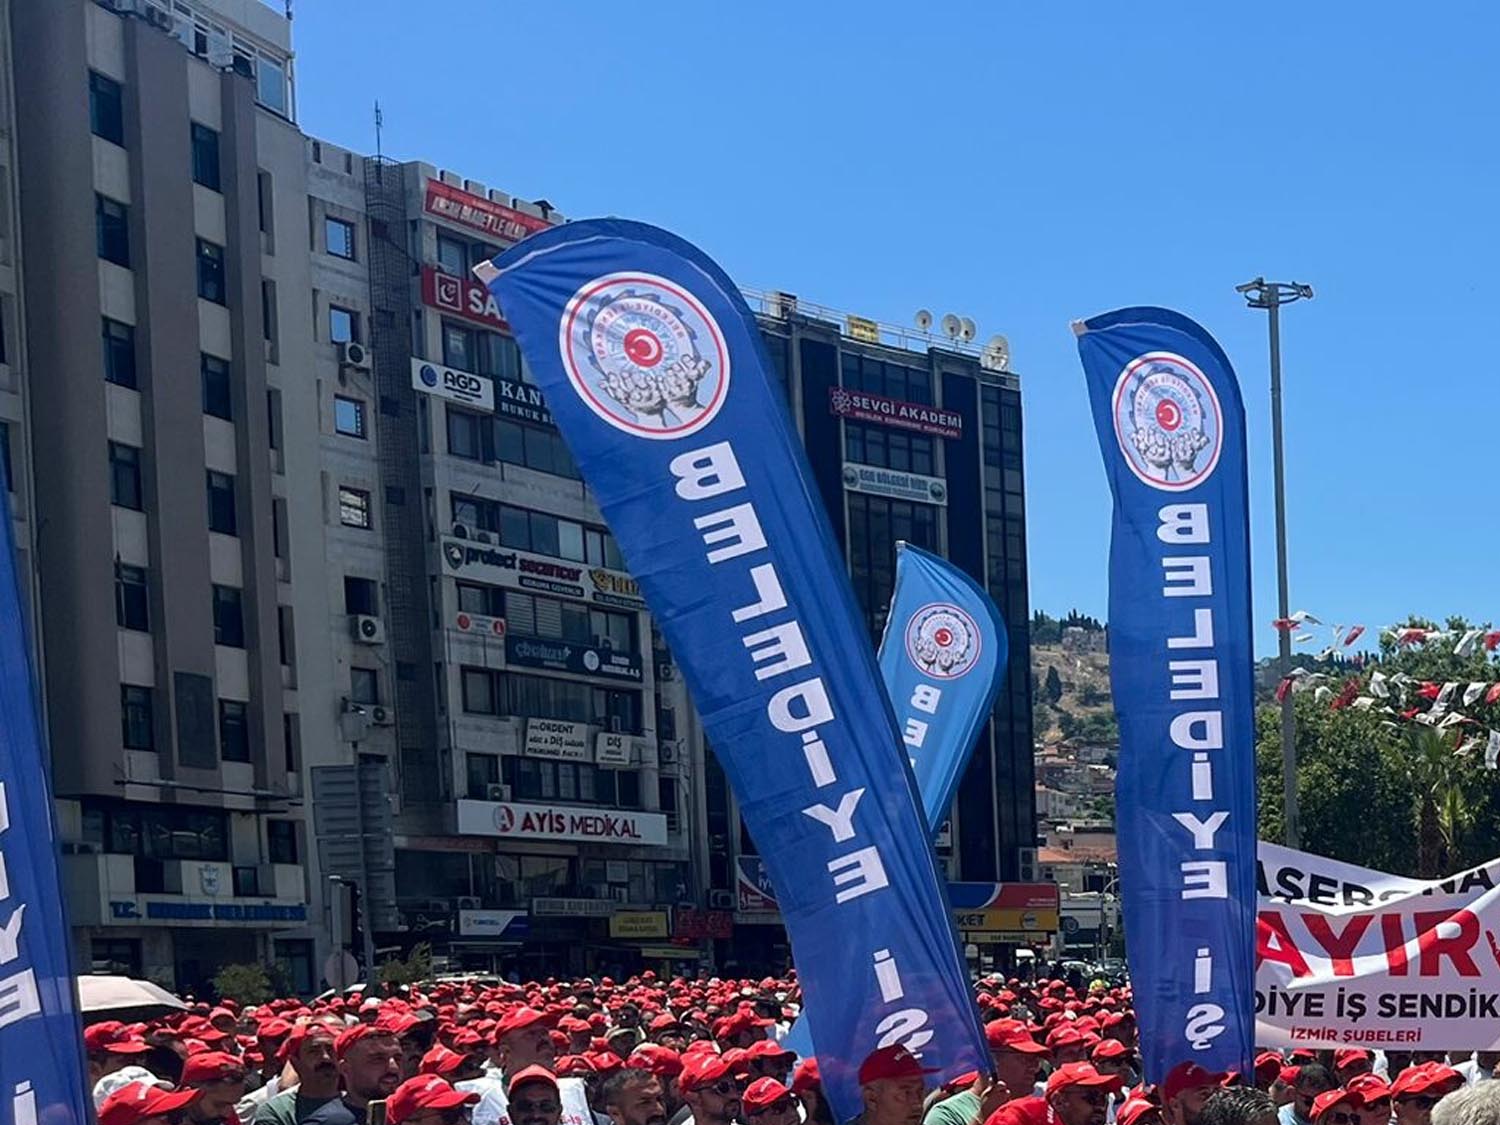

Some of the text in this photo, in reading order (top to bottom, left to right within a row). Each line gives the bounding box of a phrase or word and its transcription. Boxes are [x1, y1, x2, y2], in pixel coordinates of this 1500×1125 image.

[443, 370, 481, 393] AGD
[852, 395, 962, 428] SEVGİ AKADEMİ
[521, 810, 642, 839] AYİS MEDİKAL
[1337, 988, 1366, 1022] İŞ
[1290, 1027, 1422, 1043] İZMİR ŞUBELERİ
